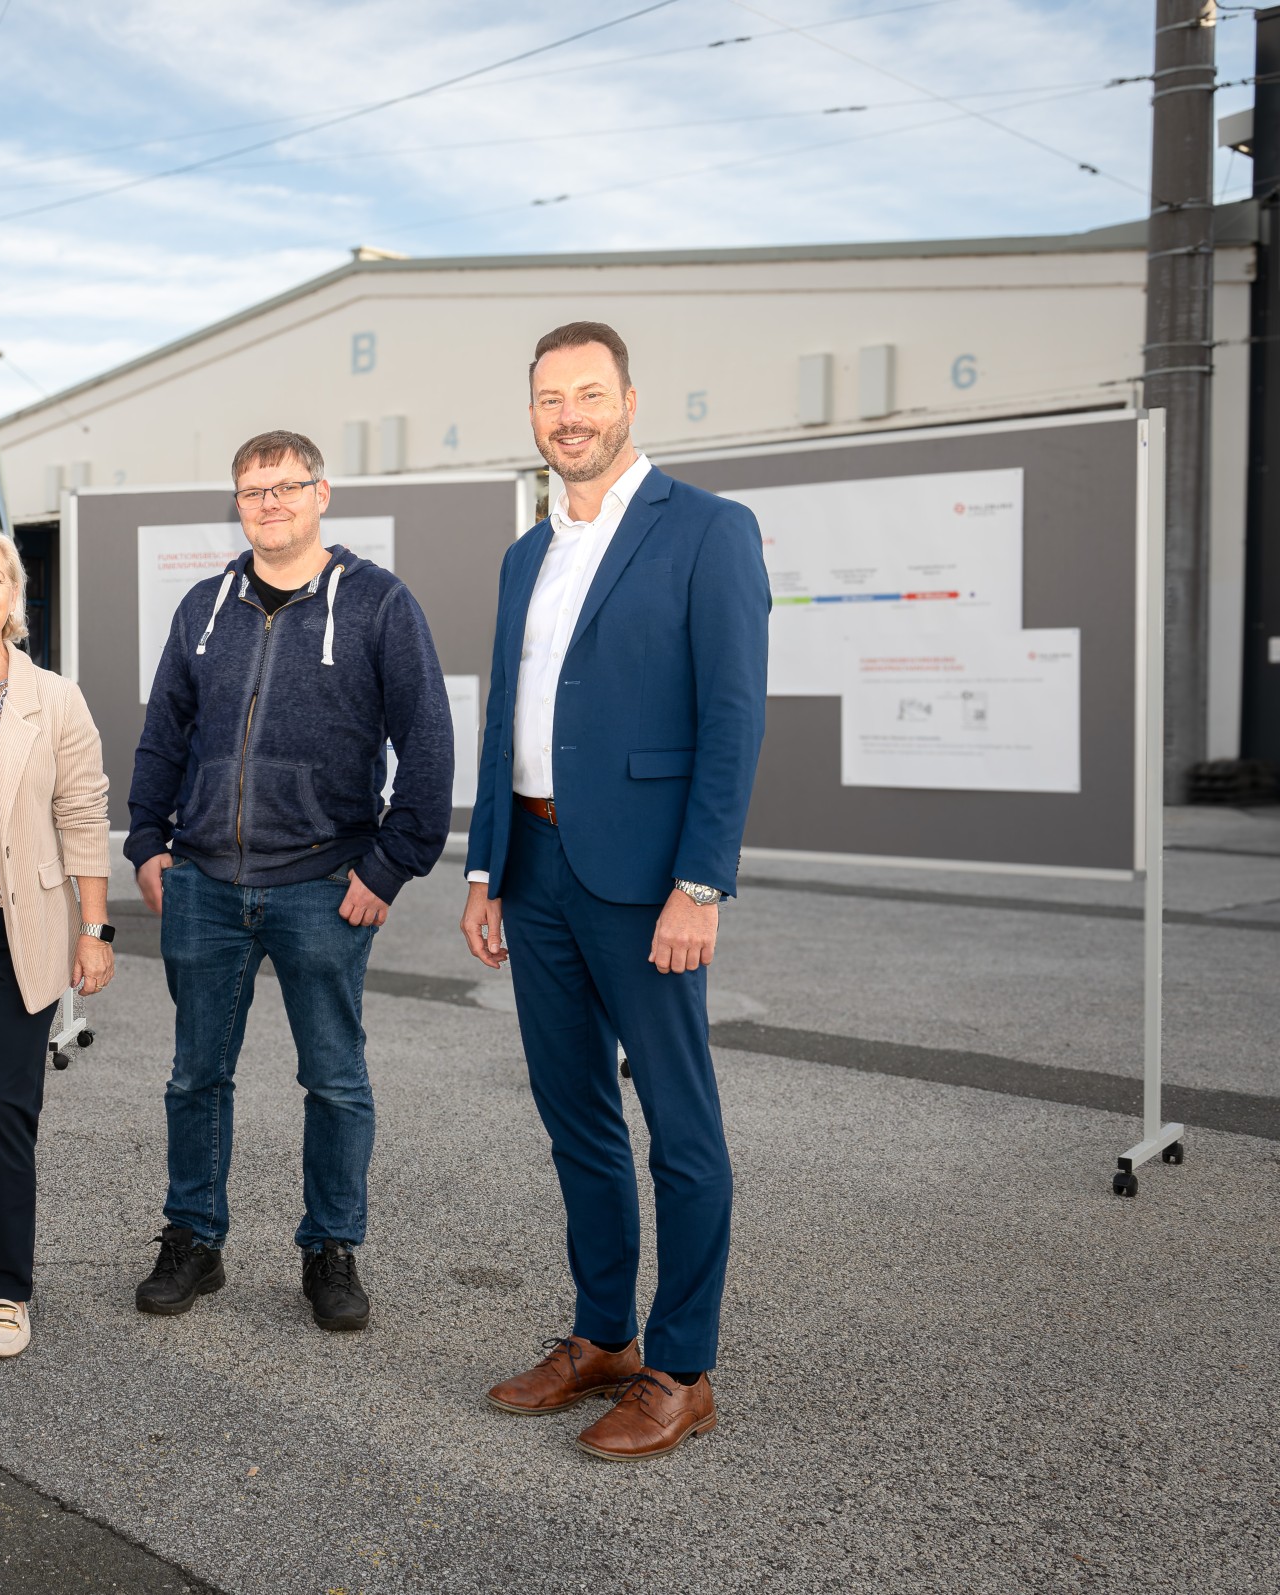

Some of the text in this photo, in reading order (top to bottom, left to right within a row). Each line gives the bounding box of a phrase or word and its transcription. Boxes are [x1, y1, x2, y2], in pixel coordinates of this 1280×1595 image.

[350, 331, 377, 375] B
[950, 353, 979, 390] 6
[686, 390, 708, 422] 5
[443, 424, 459, 452] 4
